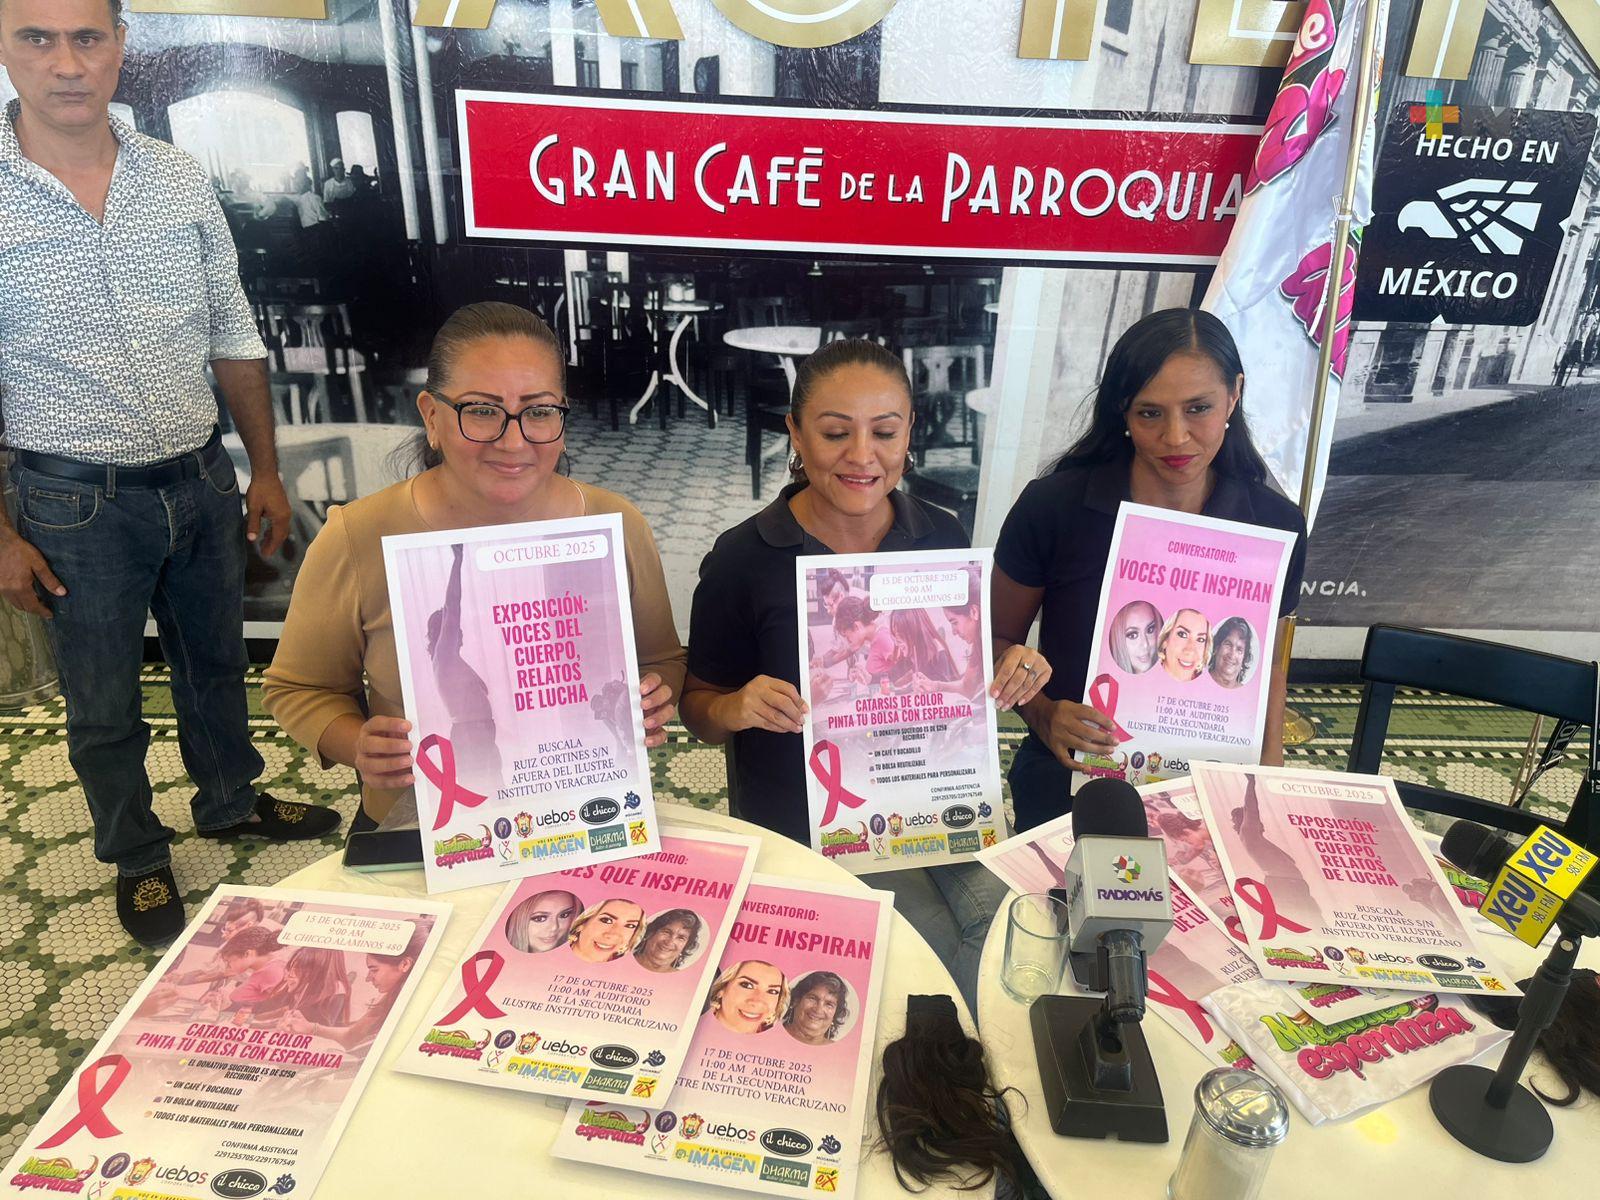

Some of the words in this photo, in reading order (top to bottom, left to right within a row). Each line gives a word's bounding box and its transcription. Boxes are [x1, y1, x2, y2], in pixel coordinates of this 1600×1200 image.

[1415, 133, 1513, 161] HECHO
[1520, 140, 1559, 164] EN
[529, 133, 675, 205] GRAN
[841, 171, 874, 201] DE
[888, 174, 924, 203] LA
[942, 152, 1242, 222] PARROQUIA
[1378, 261, 1518, 299] MÉXICO
[493, 544, 560, 564] OCTUBRE
[566, 541, 596, 557] 2025
[1168, 540, 1238, 564] CONVERSATORIO:
[1119, 558, 1166, 586] VOCES
[1169, 567, 1200, 592] QUE
[1202, 573, 1273, 604] INSPIRAN
[1300, 580, 1367, 597] NCIA.
[493, 591, 588, 624] EXPOSICIÓN:
[502, 621, 551, 646] VOCES
[555, 618, 583, 639] DEL
[514, 641, 581, 667] CUERPO,
[517, 662, 582, 689] RELATOS
[514, 691, 535, 712] DE
[539, 683, 589, 708] LUCHA
[855, 696, 898, 713] CATARSIS
[901, 696, 913, 709] DE
[915, 693, 943, 708] COLOR
[1157, 695, 1166, 704] 17
[1167, 697, 1177, 706] DE
[1178, 699, 1212, 711] OCTUBRE
[1213, 703, 1230, 714] 2025
[828, 714, 854, 729] PINTA
[856, 712, 868, 726] TU
[871, 711, 899, 725] BOLSA
[902, 709, 919, 722] CON
[922, 705, 973, 721] ESPERANZA
[1158, 715, 1168, 724] DE
[1169, 717, 1179, 726] LA
[1180, 719, 1225, 734] SECUNDARIA
[1174, 708, 1186, 717] AM
[1189, 710, 1229, 724] AUDITORIO
[1127, 720, 1157, 733] ILUSTRE
[1158, 725, 1197, 739] INSTITUTO
[1198, 731, 1251, 747] VERACRUZANO
[538, 738, 583, 754] BUSCALA
[514, 758, 538, 771] RUIZ
[540, 749, 590, 767] CORTINES
[592, 746, 610, 760] S/N
[512, 768, 551, 785] AFUERA
[553, 765, 573, 778] DEL
[575, 758, 615, 774] ILUSTRE
[497, 782, 553, 800] INSTITUTO
[555, 768, 628, 791] VERACRUZANO
[1282, 782, 1341, 797] OCTUBRE
[1345, 789, 1374, 800] 2025
[1287, 813, 1379, 833] EXPOSICIÓN:
[1299, 827, 1347, 842] VOCES
[1350, 831, 1378, 846] DEL
[1314, 841, 1382, 860] CUERPO,
[1575, 851, 1591, 865] FM
[1320, 854, 1387, 872] RELATOS
[600, 865, 640, 887] QUE
[641, 871, 734, 900] INSPIRAN
[1322, 867, 1344, 881] DE
[1346, 870, 1399, 887] LUCHA
[741, 900, 820, 921] NVERSATORIO:
[1540, 894, 1556, 909] FM
[305, 915, 315, 923] 15
[317, 916, 330, 924] DE
[333, 918, 376, 929] OCTUBRE
[377, 922, 401, 931] 2025
[349, 929, 365, 938] AM
[282, 932, 292, 941] IL
[294, 934, 331, 944] CHICCO
[334, 938, 384, 949] ALAMINOS
[386, 943, 403, 952] 480
[730, 921, 771, 944] QUE
[774, 928, 872, 960] INSPIRAN
[548, 984, 572, 994] 11:00
[574, 988, 590, 997] AM
[594, 991, 650, 1007] AUDITORIO
[553, 974, 564, 983] 17
[566, 976, 580, 985] DE
[582, 979, 629, 993] OCTUBRE
[631, 986, 654, 997] 2025
[502, 997, 542, 1011] ILUSTRE
[545, 1004, 600, 1020] INSTITUTO
[603, 1014, 678, 1033] VERACRUZANO
[548, 994, 561, 1004] DE
[564, 996, 577, 1006] LA
[578, 999, 642, 1016] SECUNDARIA
[185, 1023, 249, 1043] CATARSIS
[249, 1030, 267, 1046] DE
[268, 1032, 313, 1049] COLOR
[1297, 1007, 1476, 1080] esperanza
[136, 1032, 176, 1051] PINTA
[176, 1037, 193, 1051] TU
[194, 1039, 239, 1058] BOLSA
[240, 1044, 267, 1061] CON
[268, 1048, 344, 1069] ESPERANZA
[704, 1047, 716, 1056] 17
[718, 1049, 731, 1059] DE
[735, 1052, 785, 1068] OCTUBRE
[788, 1061, 812, 1073] 2025
[188, 1058, 197, 1067] EL
[196, 1059, 228, 1071] DONATIVO
[228, 1063, 261, 1075] SUGERIDO
[260, 1067, 269, 1075] ES
[269, 1068, 279, 1077] DE
[700, 1058, 726, 1070] 11:00
[727, 1063, 745, 1073] AM
[751, 1067, 812, 1085] AUDITORIO
[173, 1081, 184, 1089] UN
[184, 1081, 200, 1091] CAFÉ
[200, 1083, 206, 1091] Y
[206, 1084, 243, 1096] BOCADILLO
[702, 1069, 716, 1080] DE
[720, 1073, 733, 1083] LA
[736, 1076, 805, 1096] SECUNDARIA
[163, 1096, 172, 1105] TU
[172, 1097, 195, 1107] BOLSA
[195, 1099, 240, 1112] REUTILIZABLE
[701, 1082, 761, 1099] INSTITUTO
[764, 1092, 847, 1114] VERACRUZANO
[153, 1111, 175, 1121] TODOS
[176, 1113, 189, 1122] LOS
[189, 1115, 229, 1128] MATERIALES
[229, 1120, 246, 1130] PARA
[247, 1123, 303, 1137] PERSONALIZARLA
[706, 1122, 756, 1142] uebos
[221, 1140, 258, 1151] CONFIRMA
[259, 1144, 299, 1156] ASISTENCIA
[687, 1149, 756, 1174] IMAGEN
[155, 1166, 208, 1185] uebos
